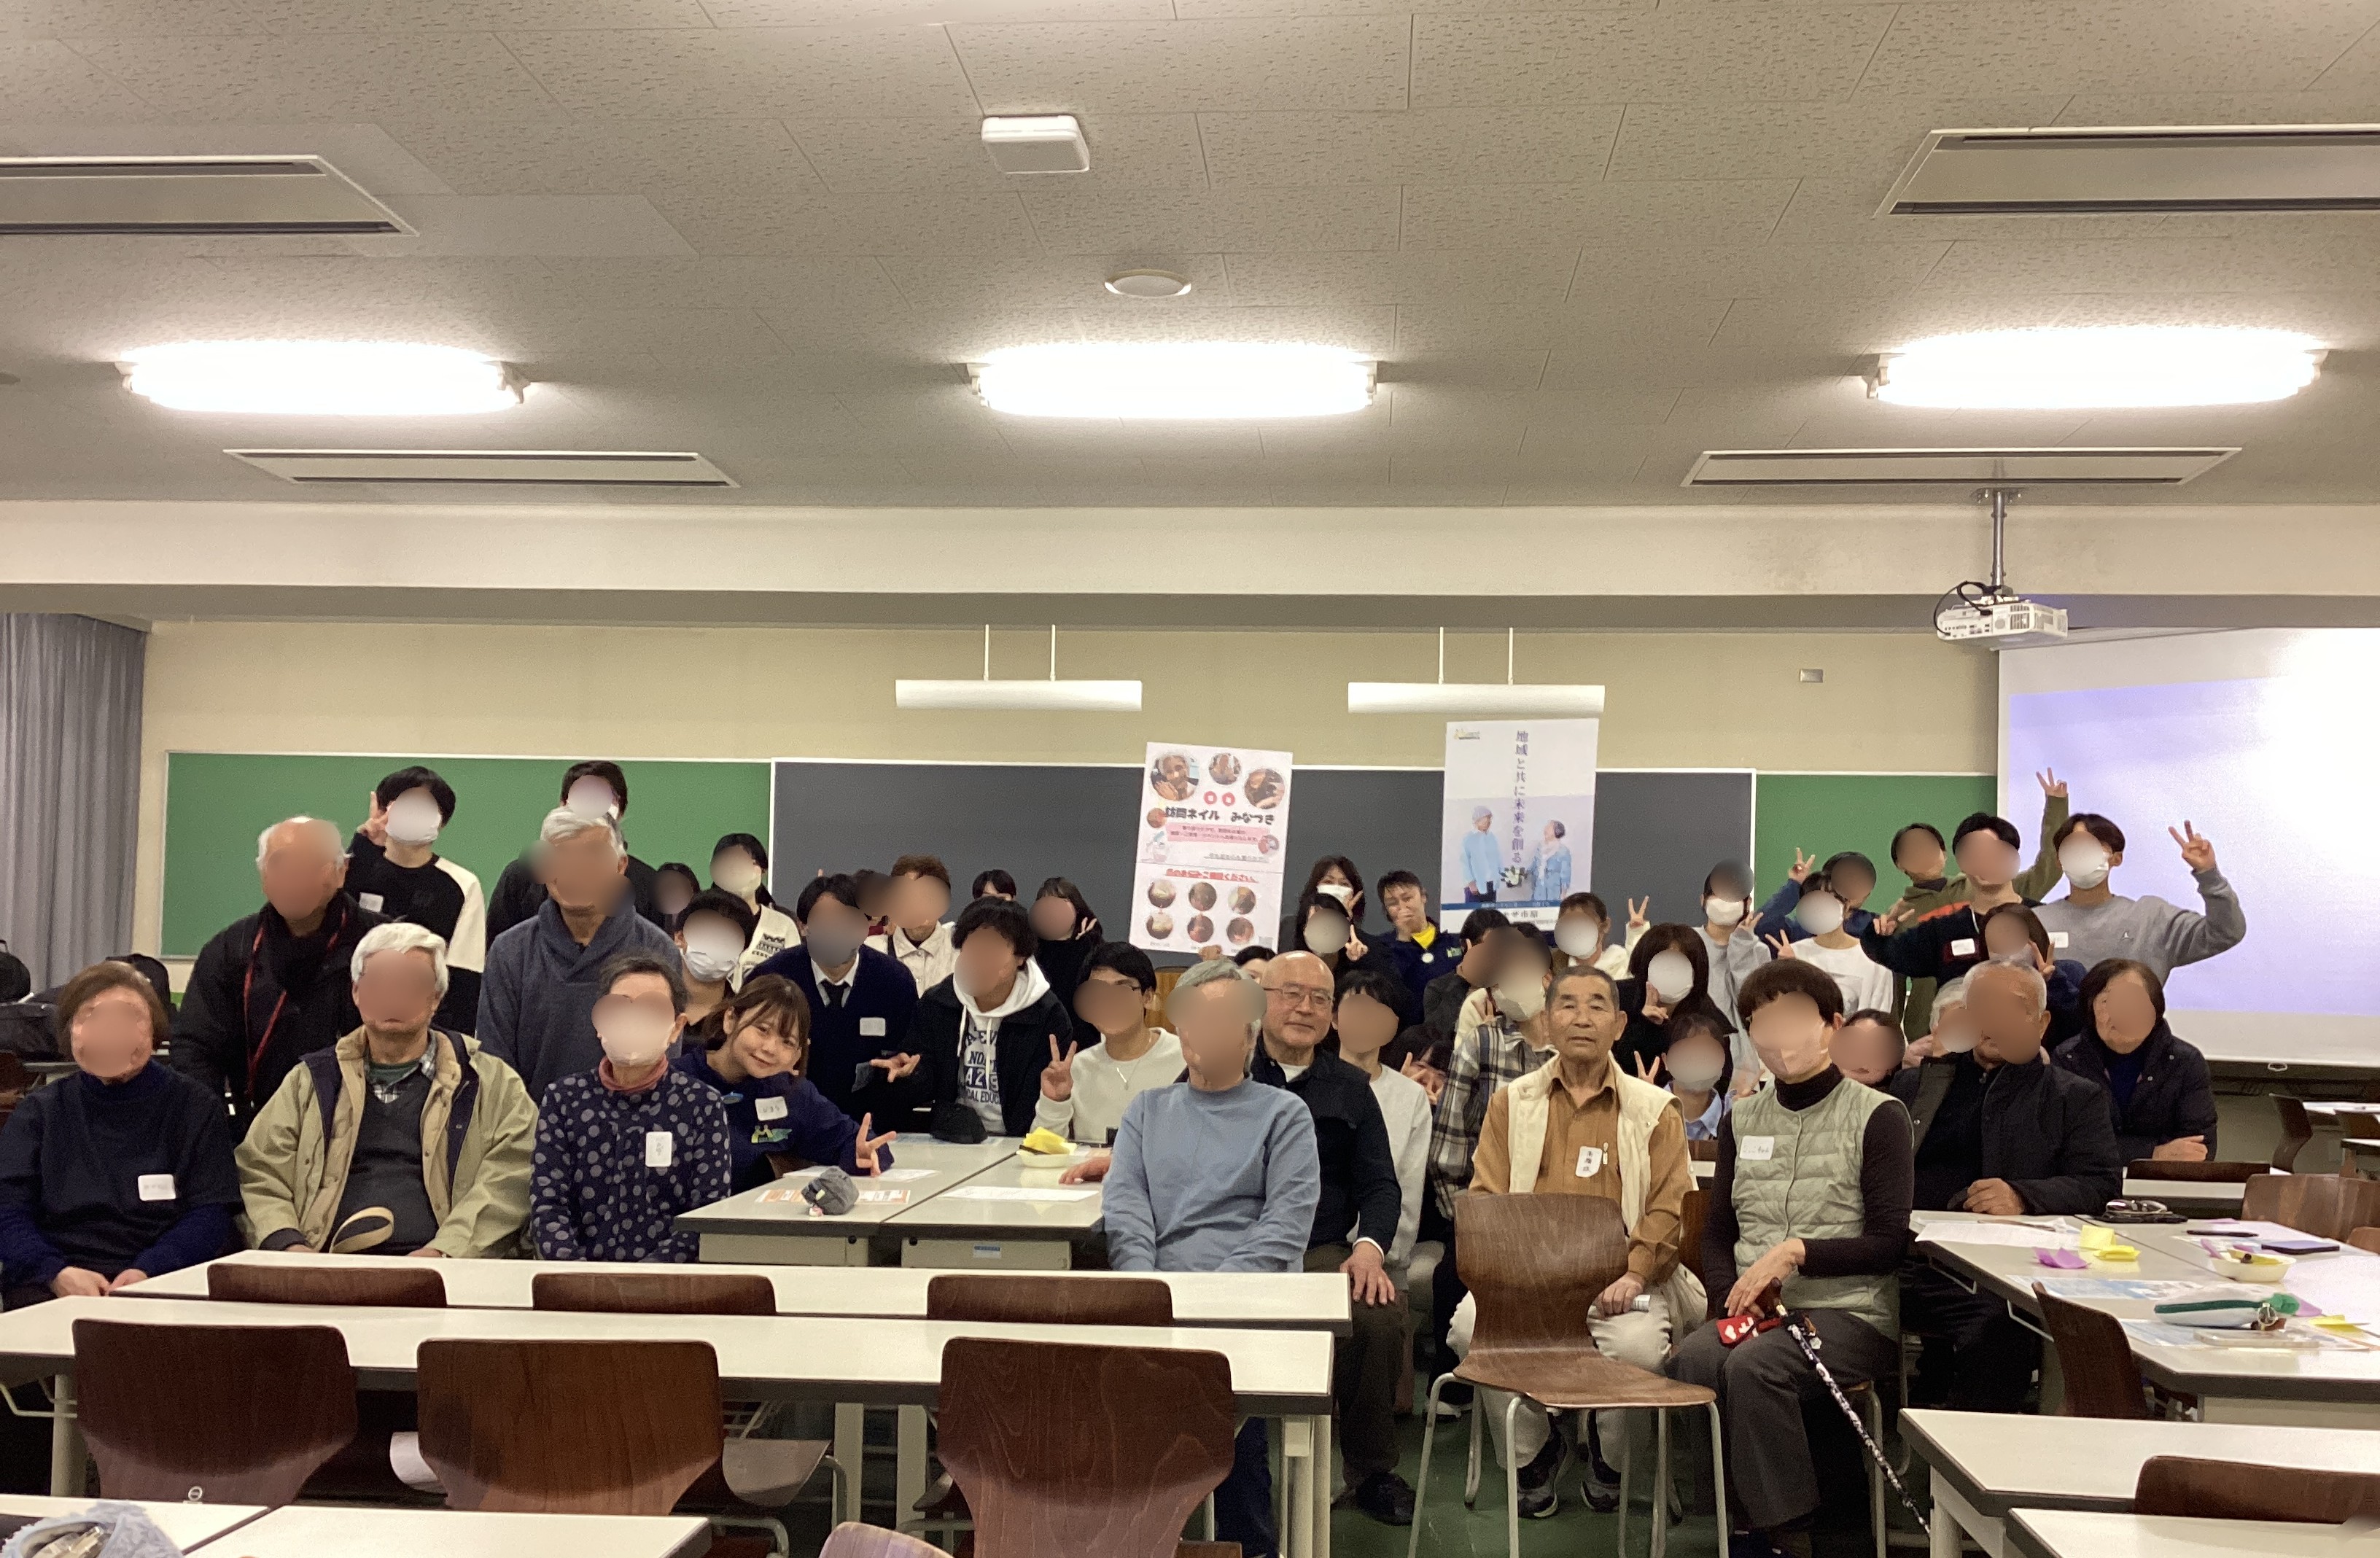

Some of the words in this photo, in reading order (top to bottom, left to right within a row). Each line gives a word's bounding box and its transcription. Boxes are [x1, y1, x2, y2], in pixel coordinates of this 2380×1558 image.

[1512, 730, 1528, 864] 地域と共に未来を創る
